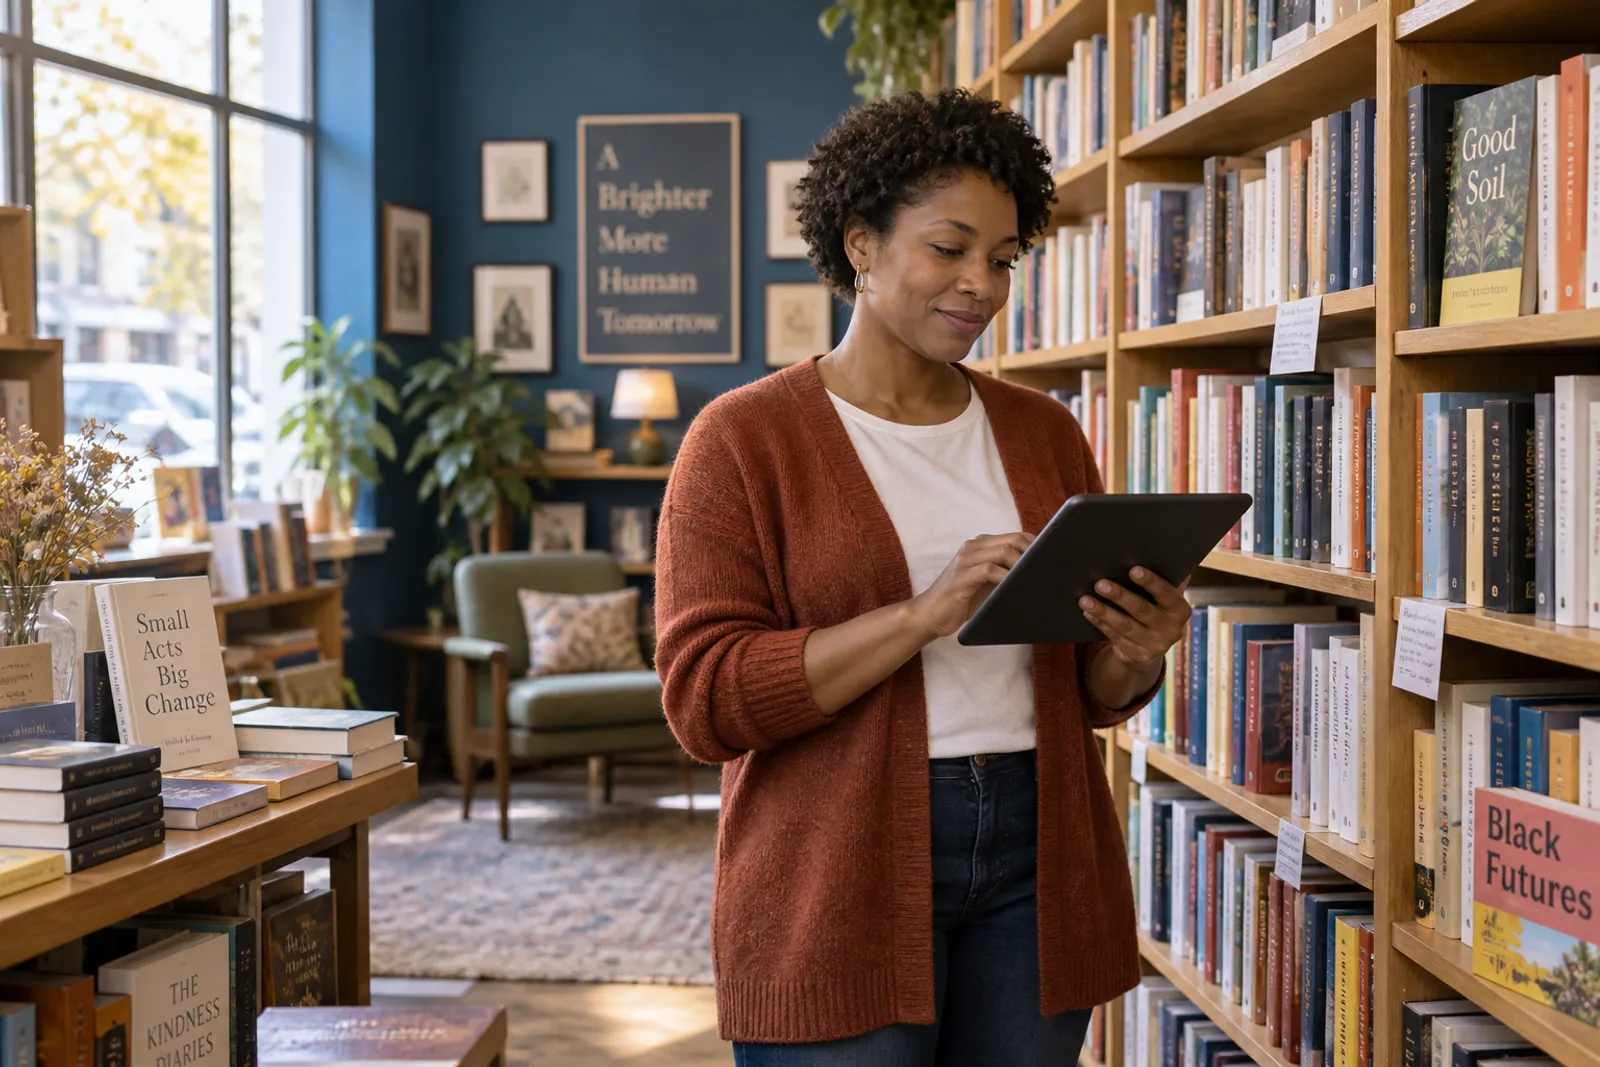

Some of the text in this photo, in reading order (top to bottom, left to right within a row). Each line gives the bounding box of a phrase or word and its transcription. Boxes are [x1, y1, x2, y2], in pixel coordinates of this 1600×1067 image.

[1463, 114, 1516, 162] Good
[597, 142, 620, 170] A
[1466, 163, 1505, 206] Soil
[598, 180, 712, 218] Brighter
[598, 225, 669, 253] More
[598, 266, 698, 294] Human
[597, 306, 722, 333] Tomorrow
[136, 609, 190, 635] Small
[143, 640, 183, 661] Acts
[156, 664, 189, 690] Big
[145, 692, 216, 716] Change
[1487, 804, 1561, 863] Black
[1486, 850, 1593, 921] Futures
[169, 974, 199, 1005] THE
[147, 997, 220, 1050] KINDNESS
